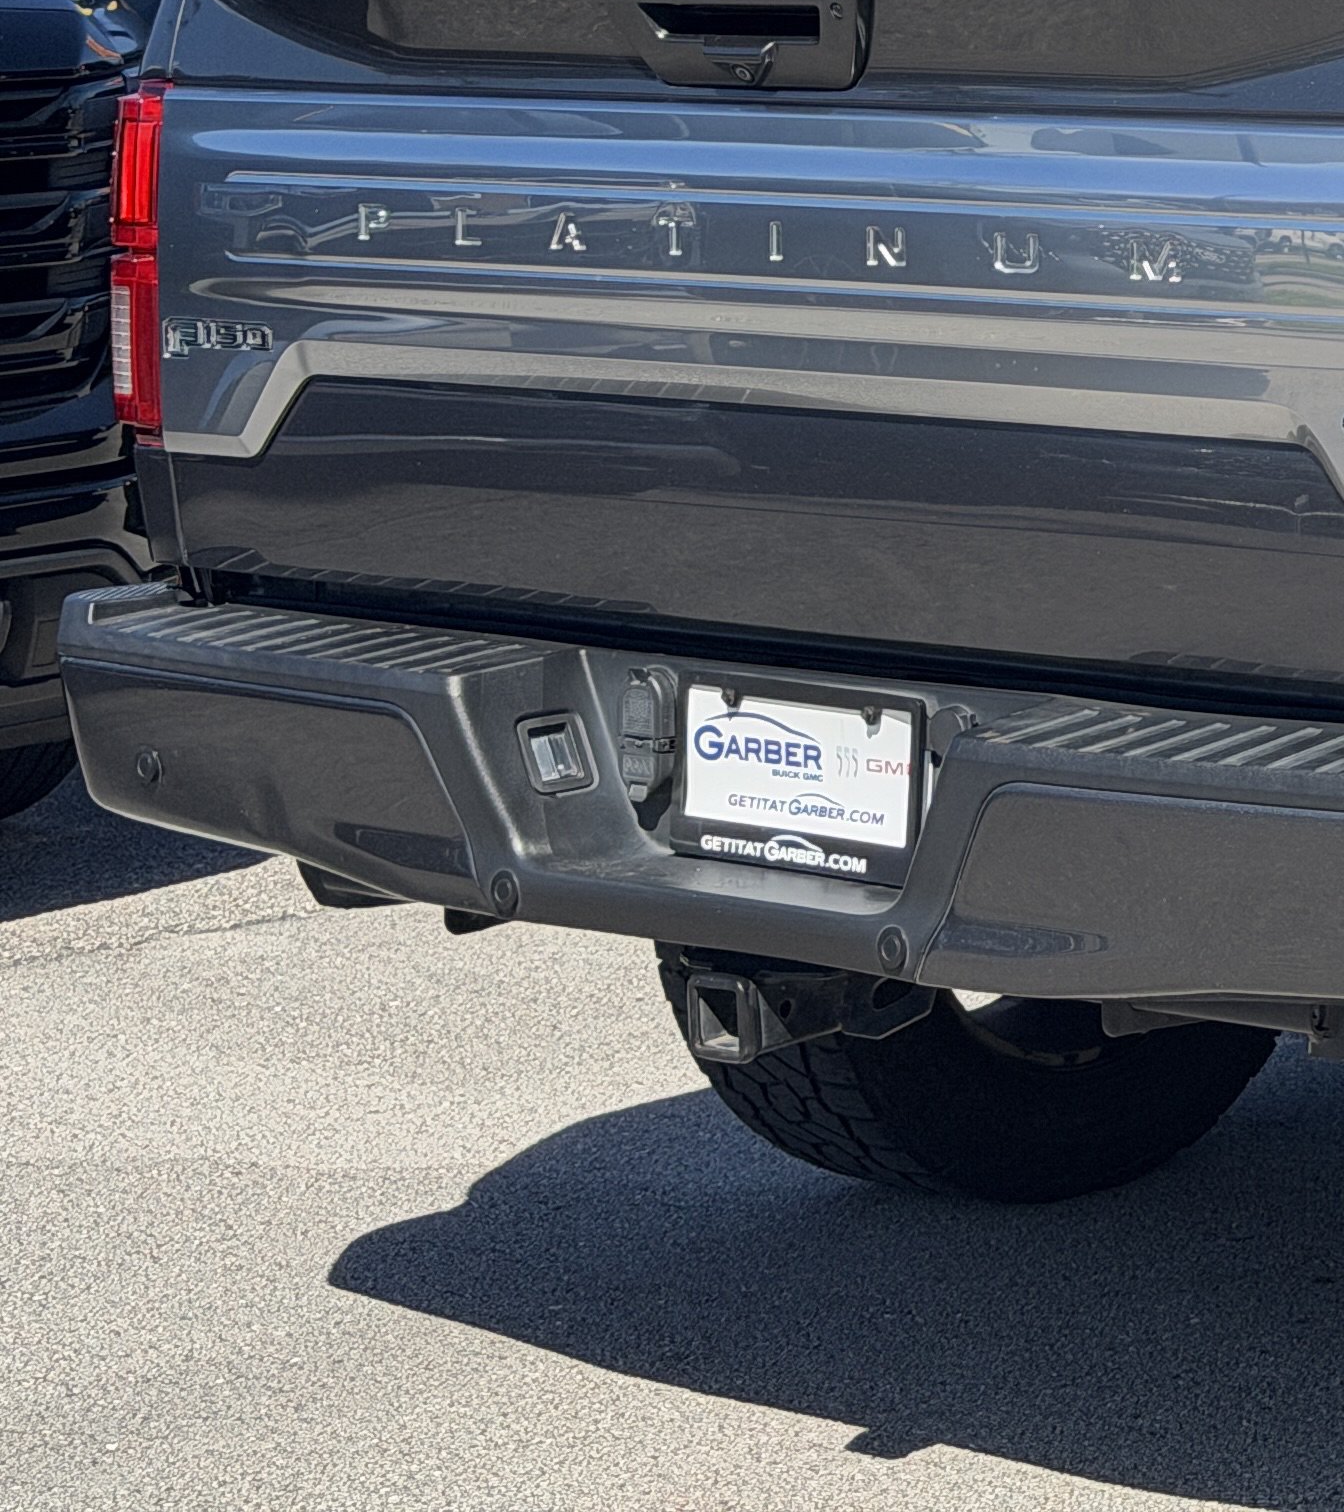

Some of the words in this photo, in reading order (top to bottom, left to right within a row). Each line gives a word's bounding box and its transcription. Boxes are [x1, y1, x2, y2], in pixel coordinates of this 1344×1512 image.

[357, 203, 1183, 284] PLATINUM
[694, 724, 822, 771] GARBER
[772, 768, 800, 780] BUICK
[802, 771, 824, 783] GMC
[866, 758, 912, 776] GM
[728, 793, 884, 826] GETITATGARBER.COM
[700, 834, 867, 874] GETITATGARBER.COM
